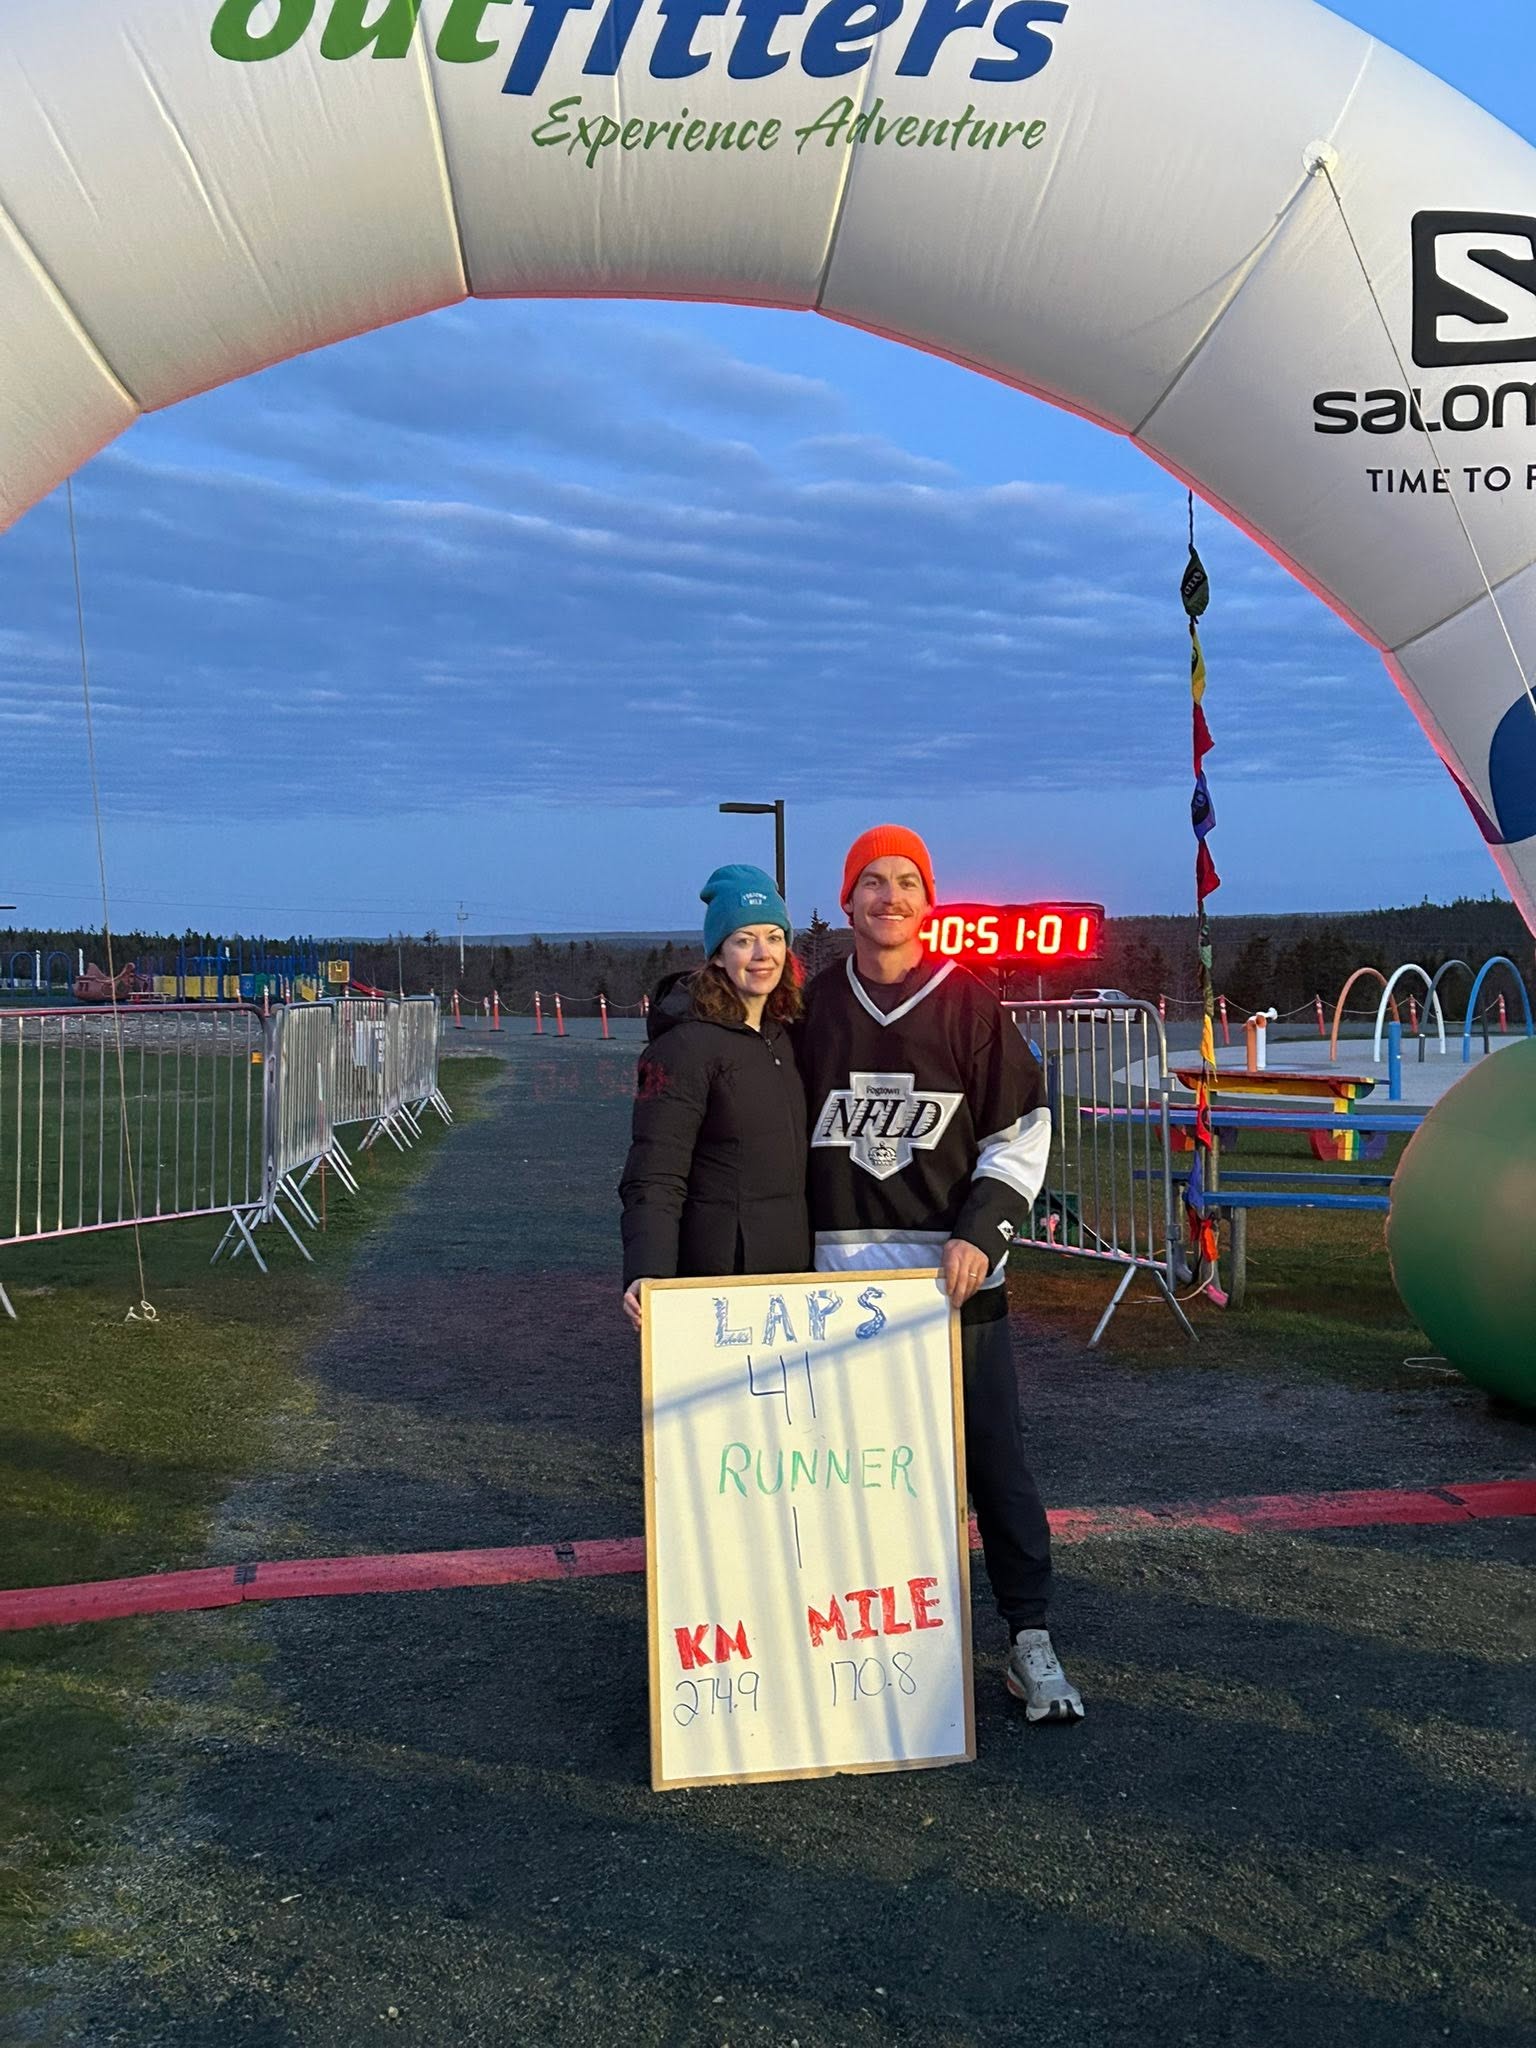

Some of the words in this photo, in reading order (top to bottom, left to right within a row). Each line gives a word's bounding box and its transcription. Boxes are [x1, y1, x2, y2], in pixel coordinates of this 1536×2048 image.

[531, 95, 782, 169] Experience
[795, 95, 1047, 155] Adventure
[1365, 467, 1453, 494] TIME
[1463, 465, 1512, 493] TO
[821, 1098, 943, 1139] NFLD
[711, 1286, 888, 1349] LAPS
[747, 1351, 817, 1425] 41
[718, 1441, 918, 1498] RUNNER
[806, 1576, 945, 1648] MILE
[673, 1619, 753, 1671] KM
[672, 1670, 760, 1727] 274.9
[829, 1651, 917, 1707] 170.8
